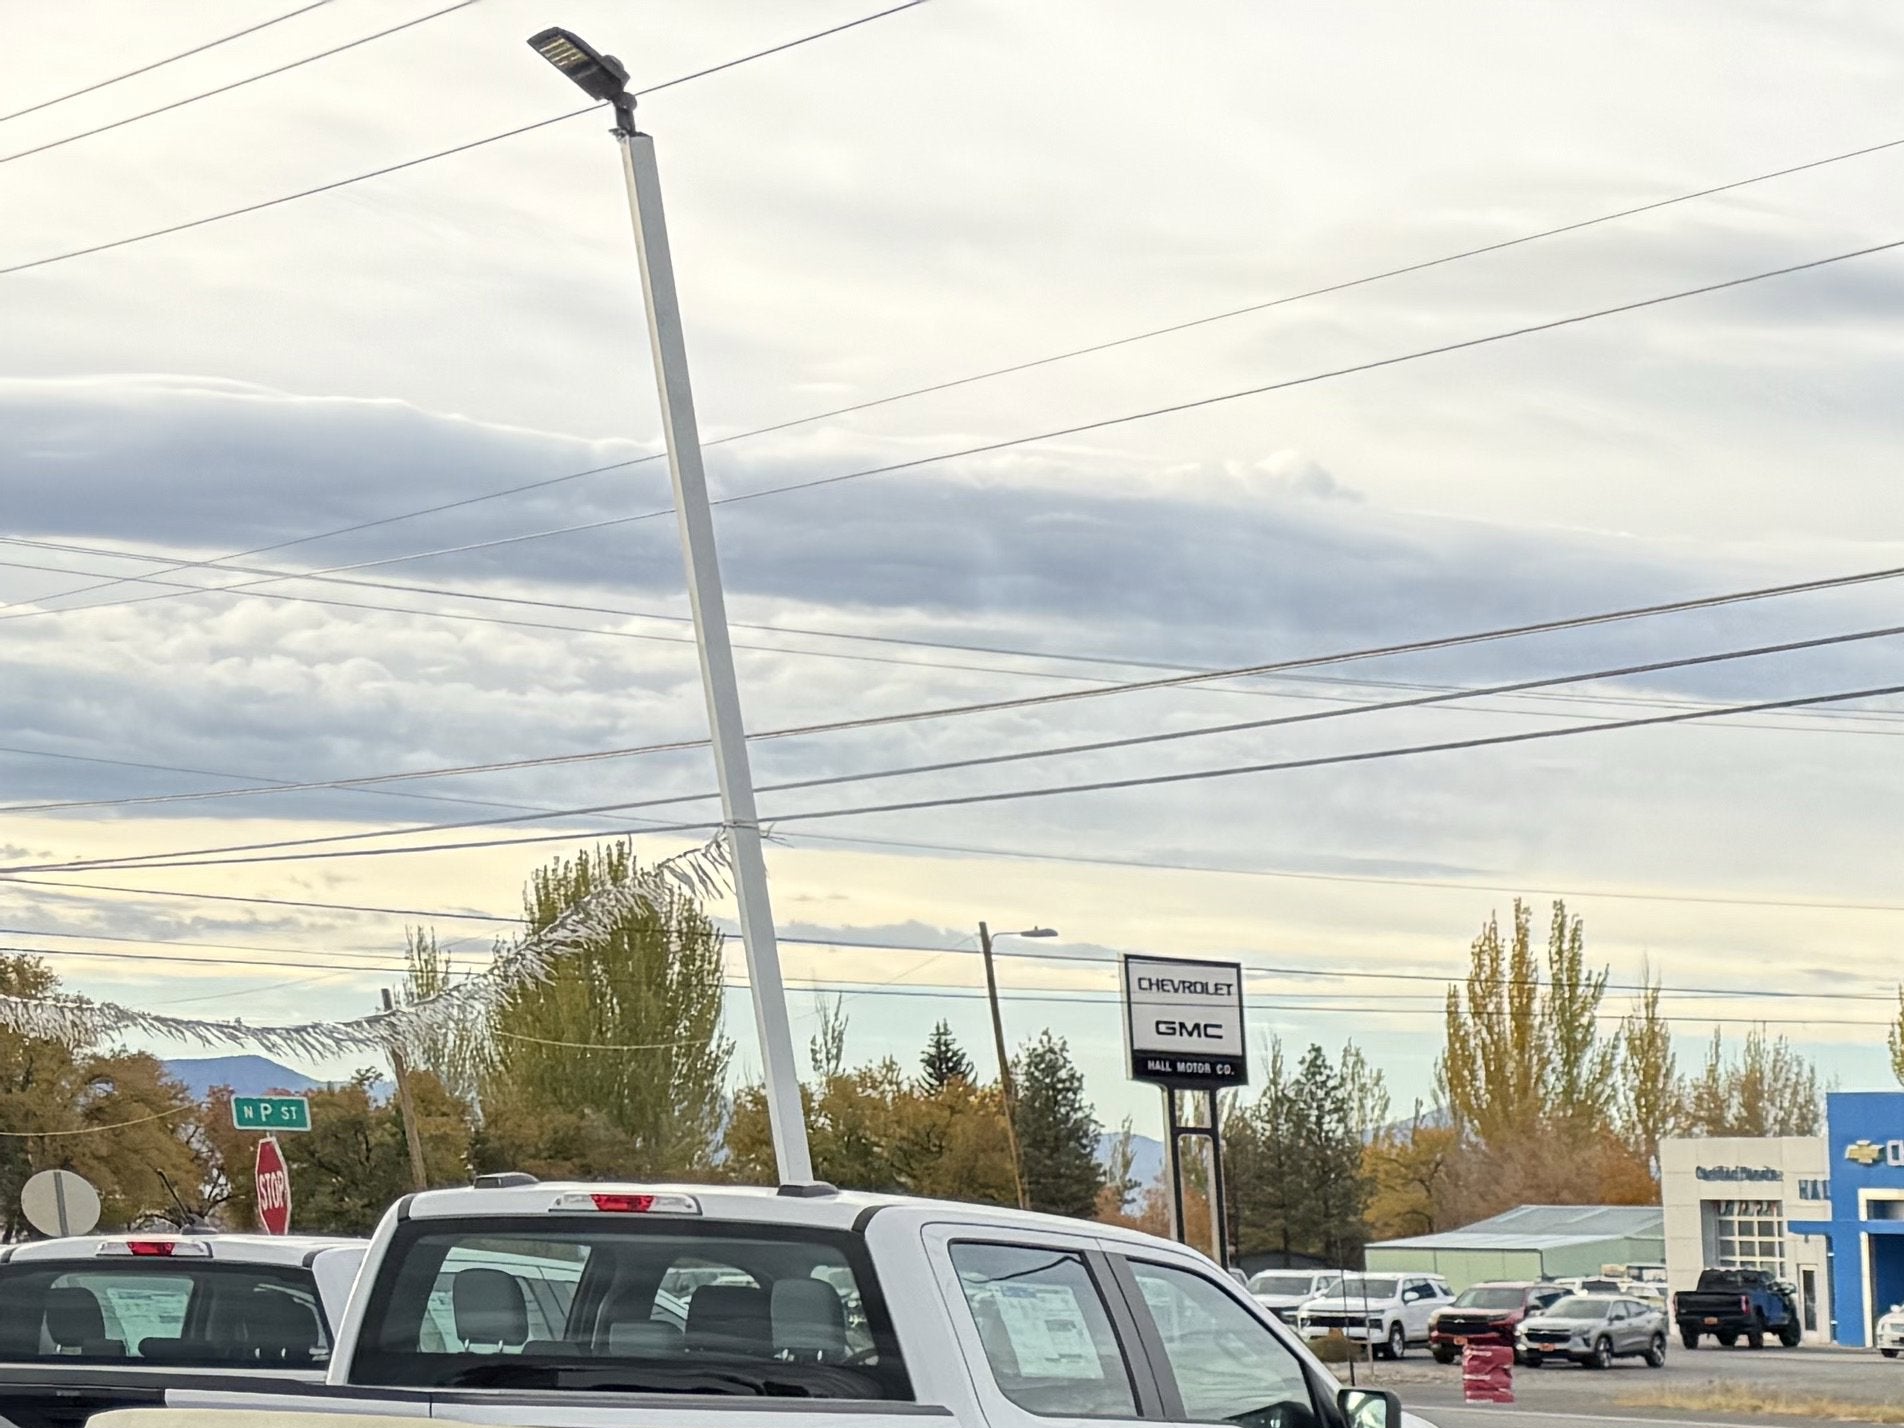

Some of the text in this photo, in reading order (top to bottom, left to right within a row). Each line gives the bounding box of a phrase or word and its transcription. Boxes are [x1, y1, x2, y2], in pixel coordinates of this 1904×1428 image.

[1137, 977, 1233, 996] CHEVROLET
[1155, 1020, 1223, 1039] GMC
[1147, 1060, 1235, 1075] HALL MOTOR CO.
[243, 1103, 297, 1121] N P ST
[259, 1170, 285, 1210] STOP
